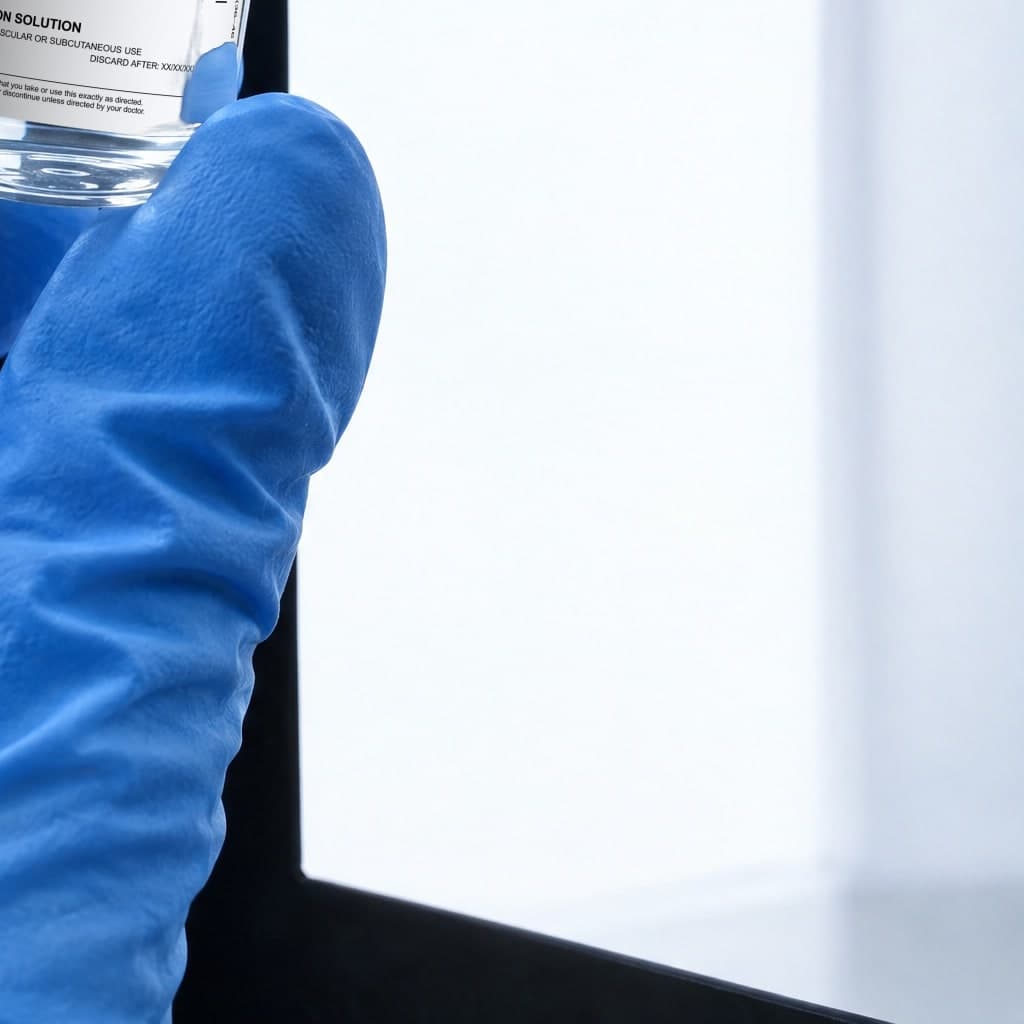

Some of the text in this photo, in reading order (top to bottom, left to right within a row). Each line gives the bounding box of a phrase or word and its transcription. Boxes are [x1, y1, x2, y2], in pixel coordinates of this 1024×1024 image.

[14, 12, 82, 33] SOLUTION
[34, 34, 48, 44] OR
[49, 36, 122, 54] SUBCUTANEOUS
[124, 46, 143, 56] USE
[89, 54, 129, 67] DISCARD
[130, 60, 159, 70] AFTER:
[2, 87, 40, 101] discontinue
[41, 95, 65, 105] unless
[66, 98, 95, 109] directed
[96, 102, 105, 111] by
[106, 105, 123, 113] your
[123, 105, 145, 115] doctor.
[10, 82, 23, 90] you
[24, 83, 39, 92] take
[49, 88, 63, 96] use
[64, 89, 77, 98] this
[78, 92, 103, 102] exactly
[114, 95, 143, 105] directed.
